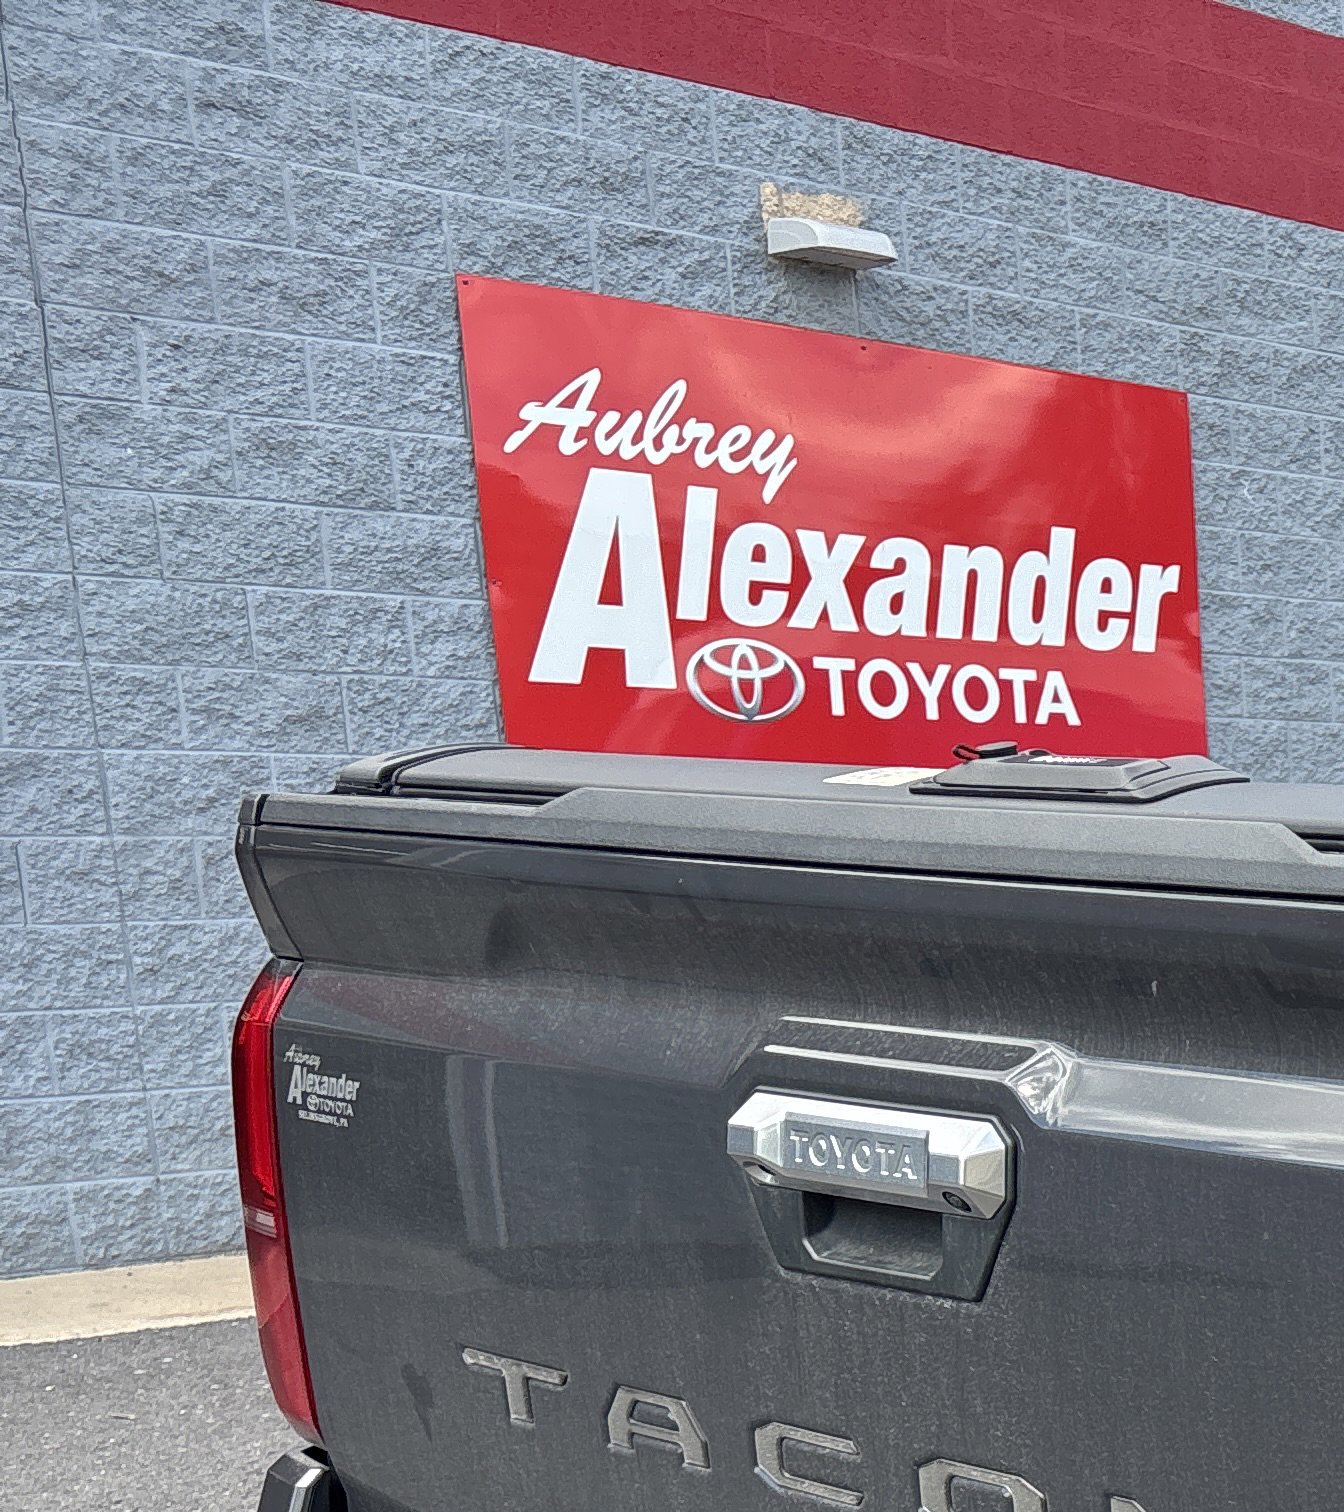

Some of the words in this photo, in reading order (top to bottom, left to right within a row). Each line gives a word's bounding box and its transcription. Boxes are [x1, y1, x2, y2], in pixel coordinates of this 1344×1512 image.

[504, 368, 797, 503] Aubrey
[528, 467, 1180, 690] Alexander
[811, 656, 1081, 727] TOYOTA
[287, 1065, 360, 1104] Alexander
[318, 1097, 354, 1117] TOYOTA
[790, 1128, 918, 1180] TOYOTA
